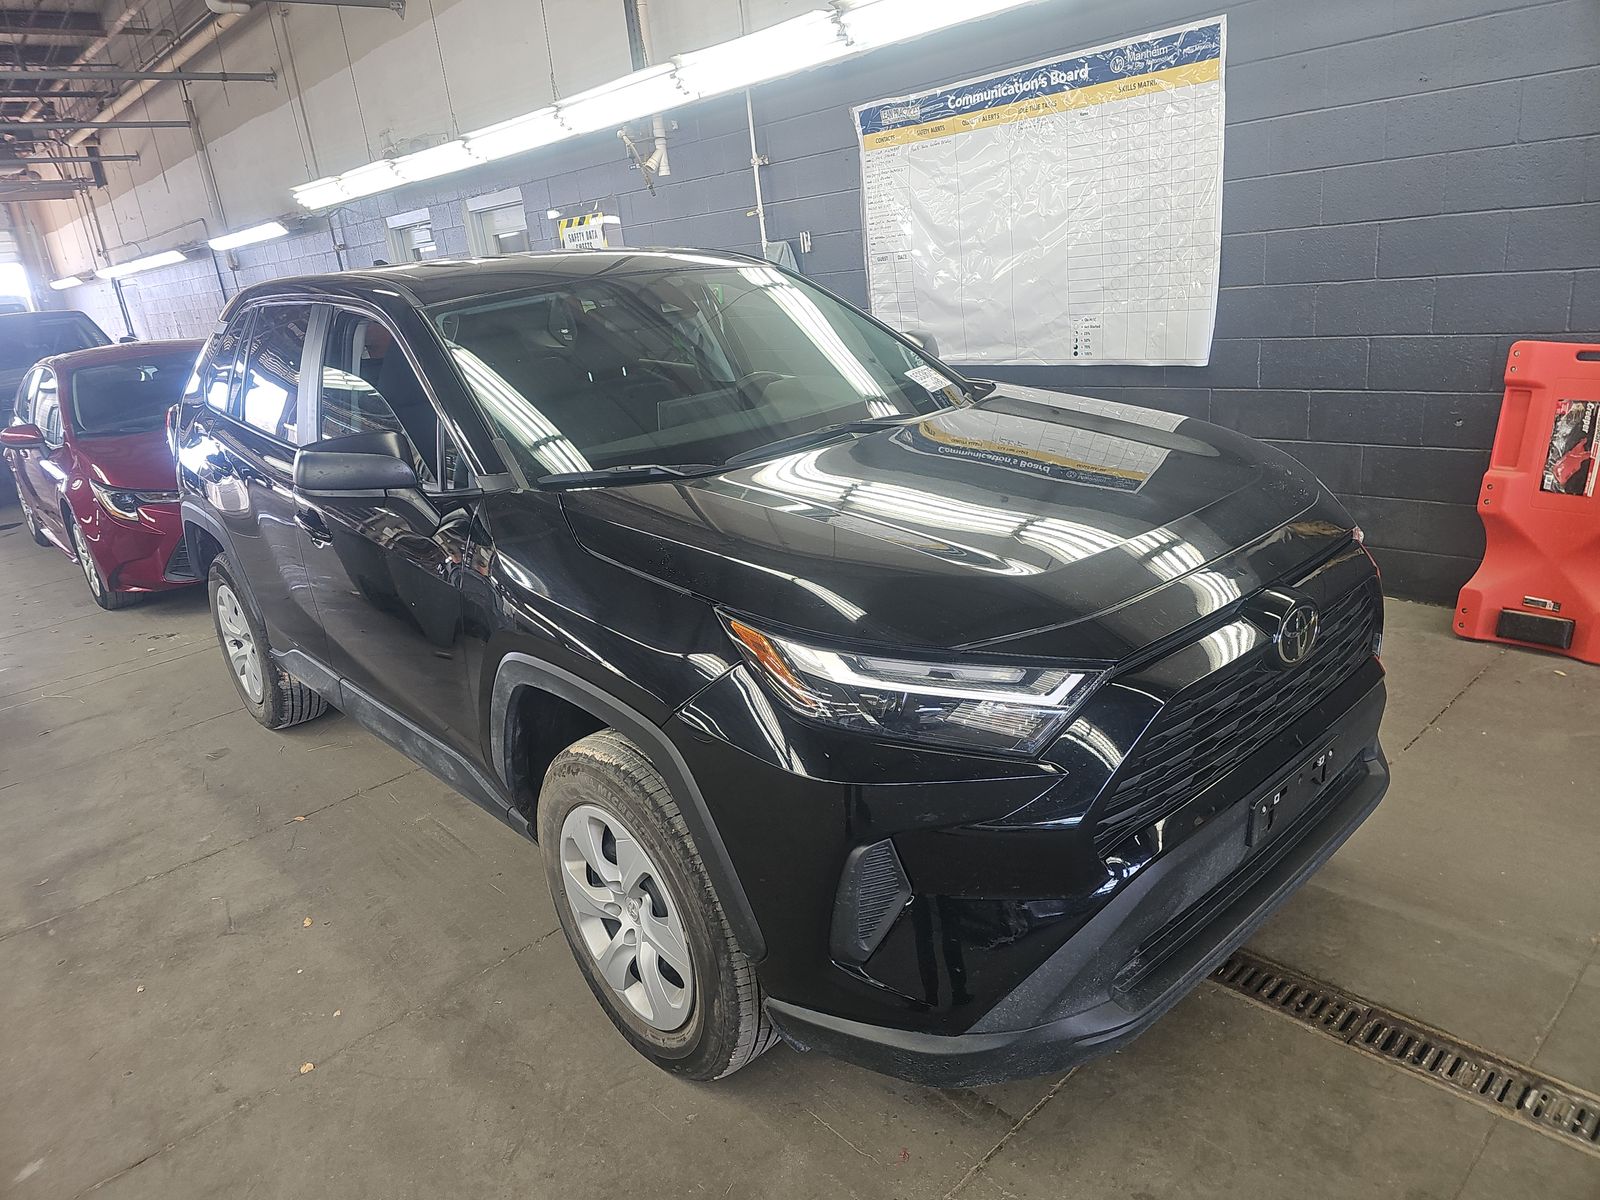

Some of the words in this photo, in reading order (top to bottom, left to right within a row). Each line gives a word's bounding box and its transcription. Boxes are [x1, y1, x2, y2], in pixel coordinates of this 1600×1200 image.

[1127, 45, 1168, 62] Manheim
[947, 74, 1047, 109] Communication's
[1050, 63, 1089, 85] Board
[1138, 80, 1159, 89] MATRI
[982, 113, 1000, 122] ALERTS
[568, 232, 585, 243] SAFETY
[586, 230, 598, 240] DATA
[1582, 401, 1594, 433] Creeper
